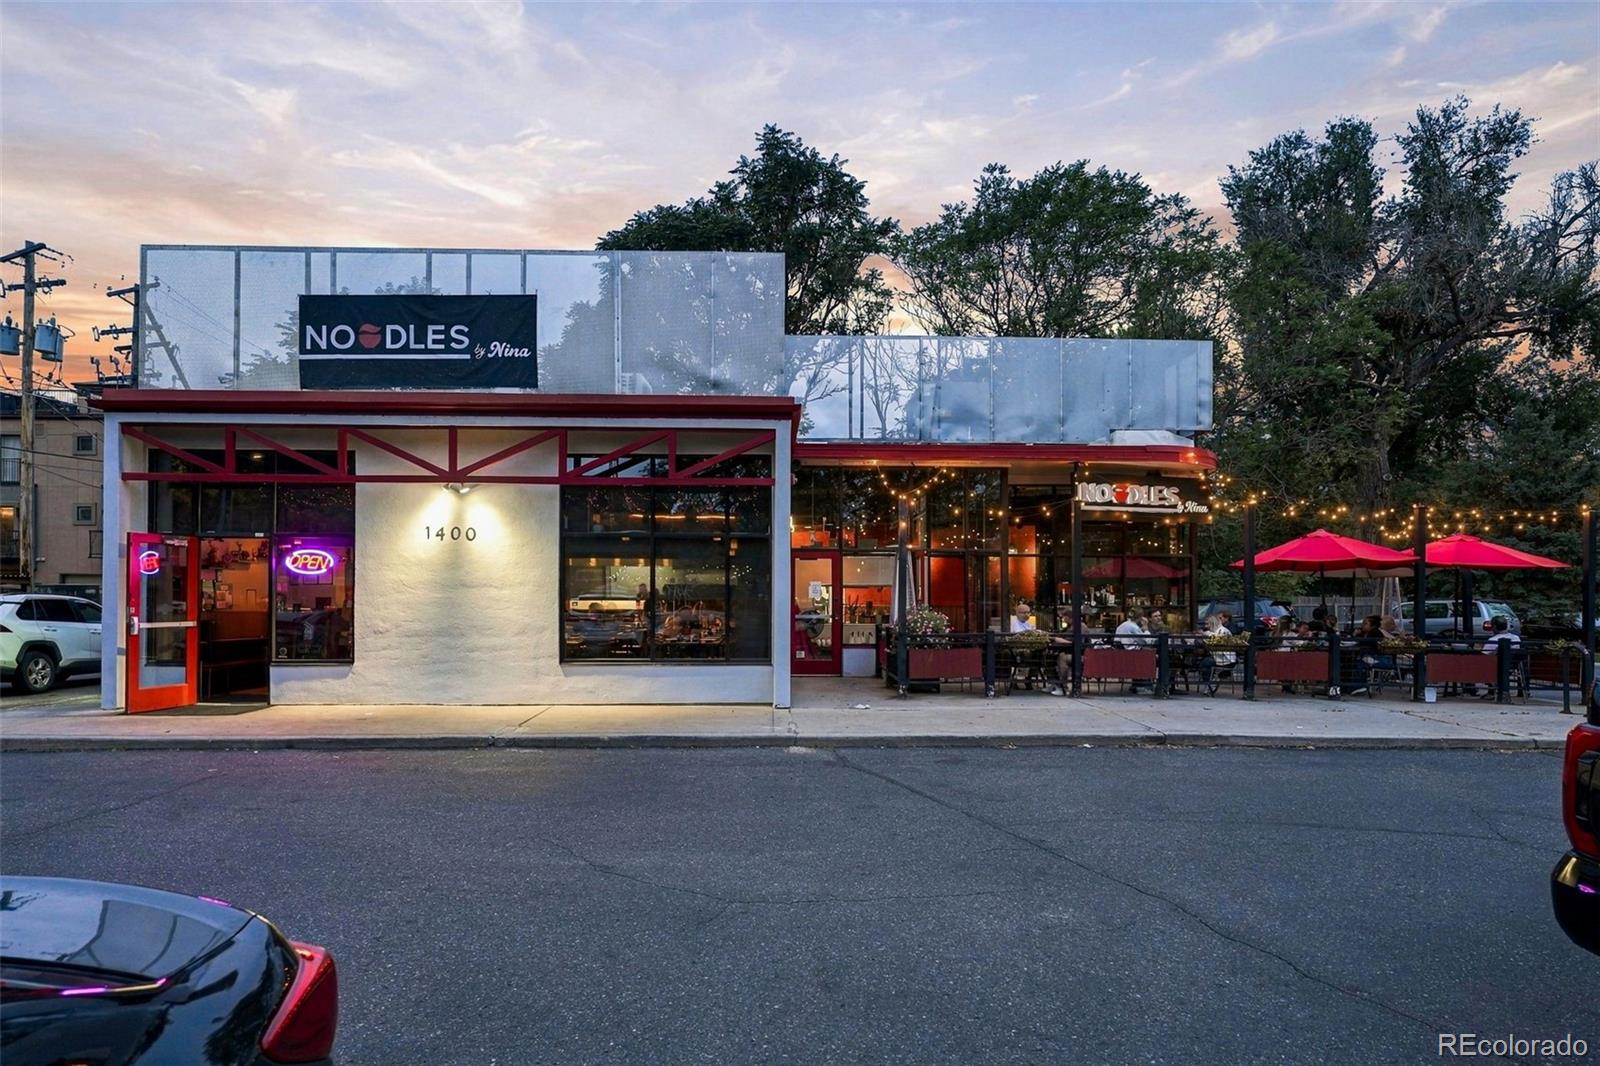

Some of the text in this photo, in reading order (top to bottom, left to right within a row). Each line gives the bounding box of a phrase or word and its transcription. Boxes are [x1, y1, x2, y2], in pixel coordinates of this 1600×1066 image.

[474, 343, 487, 360] by
[487, 341, 532, 358] Nina
[425, 526, 477, 542] 1400
[289, 554, 329, 569] OPEN
